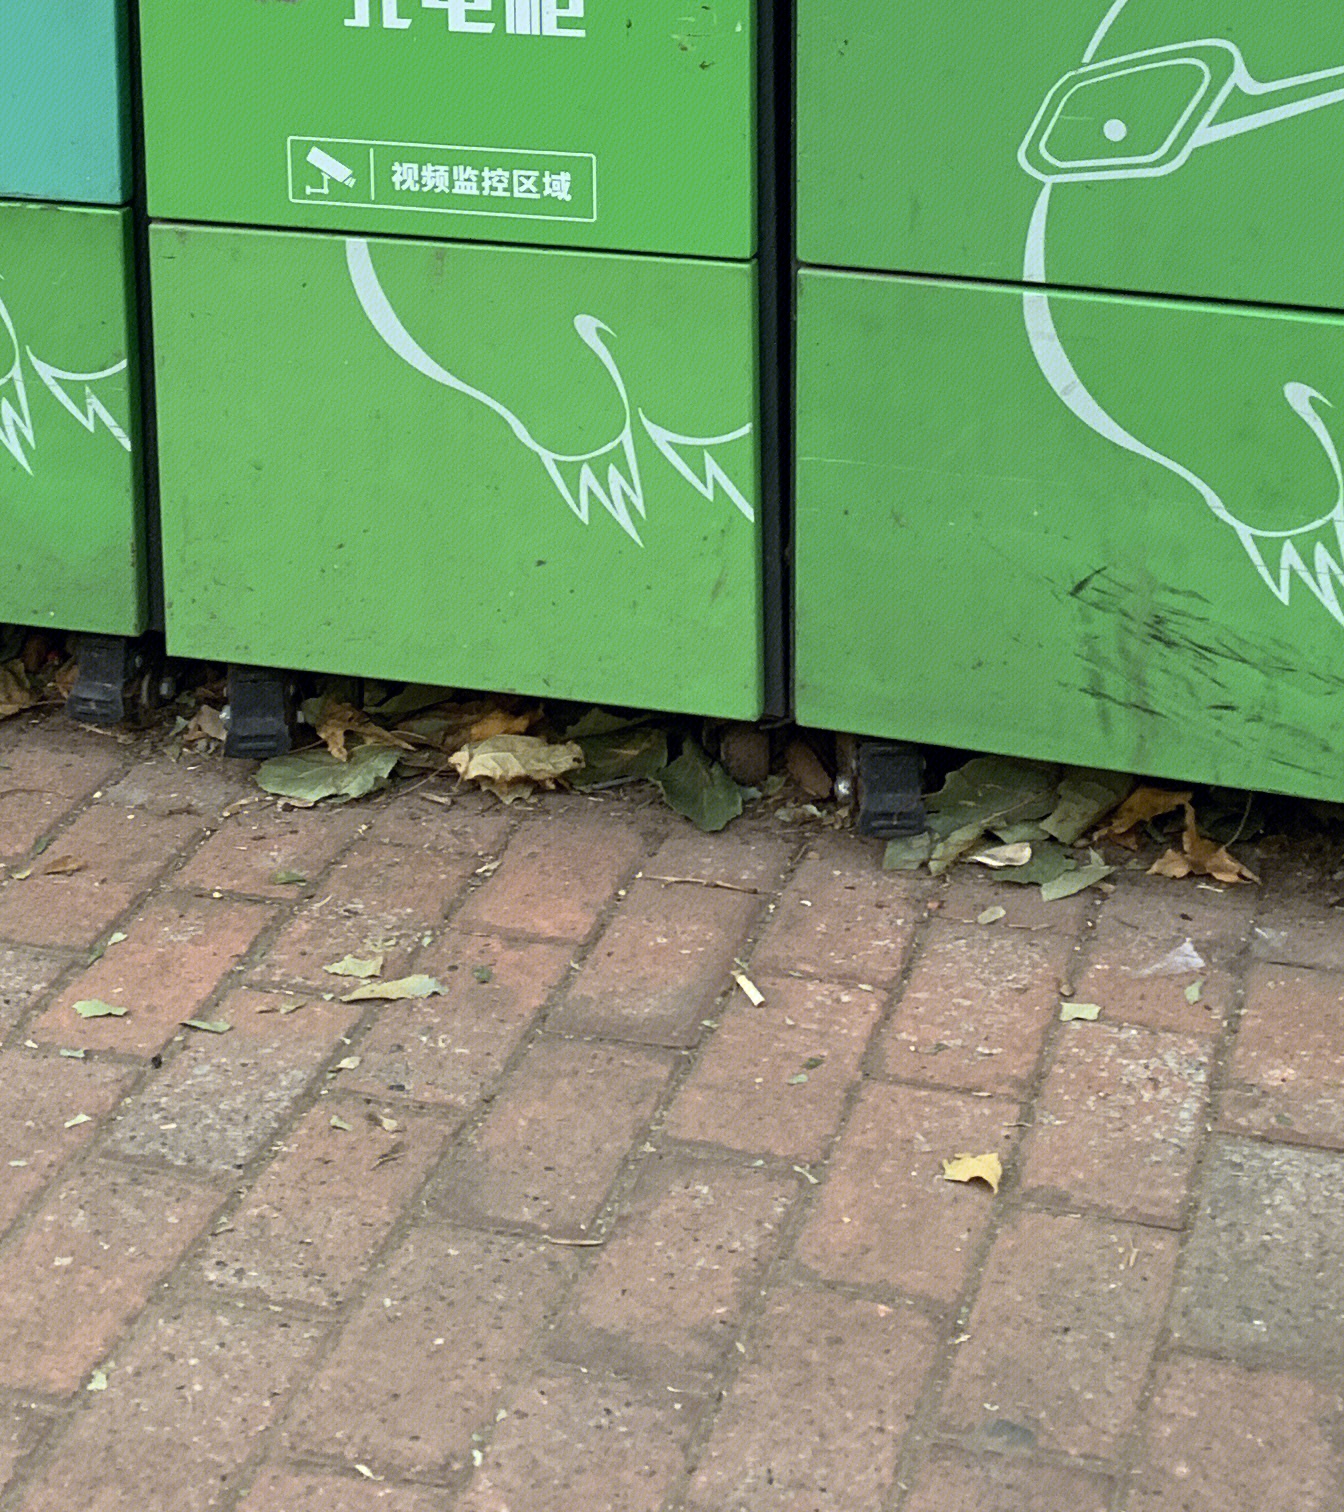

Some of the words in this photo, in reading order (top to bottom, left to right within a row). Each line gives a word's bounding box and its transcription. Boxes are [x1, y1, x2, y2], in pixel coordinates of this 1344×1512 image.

[391, 161, 573, 202] 视频监控区域
